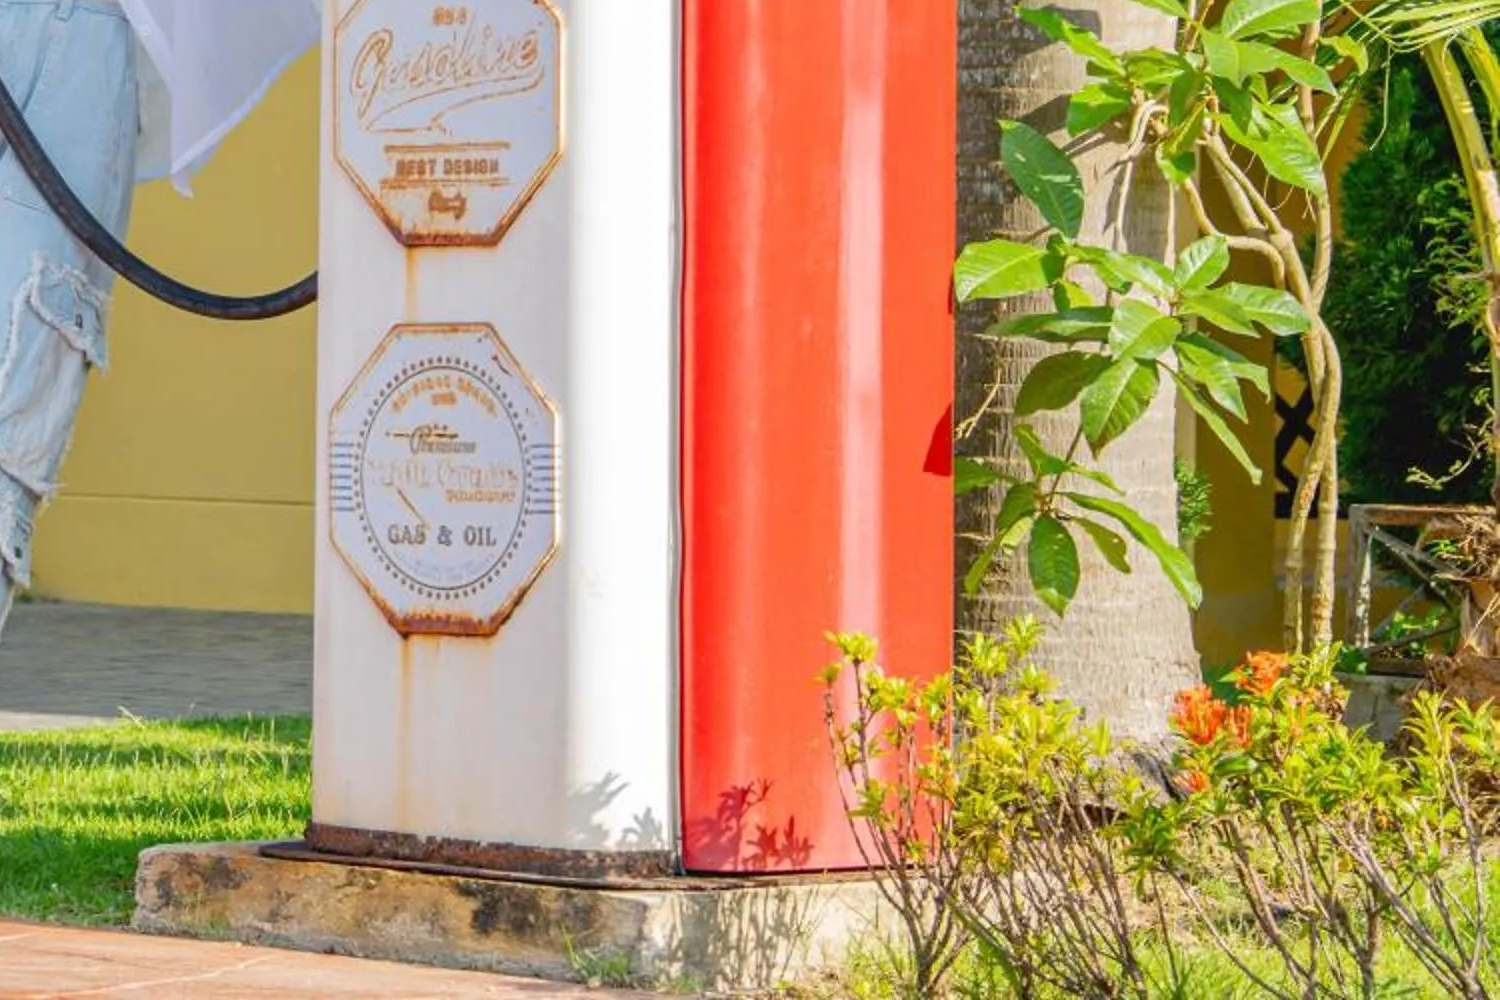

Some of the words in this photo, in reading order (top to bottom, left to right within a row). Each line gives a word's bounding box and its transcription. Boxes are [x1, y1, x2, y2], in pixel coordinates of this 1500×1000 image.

[396, 158, 436, 176] BEST
[443, 157, 499, 175] DESIGN
[387, 524, 426, 545] GAS
[437, 525, 453, 547] &
[463, 525, 497, 547] OIL
